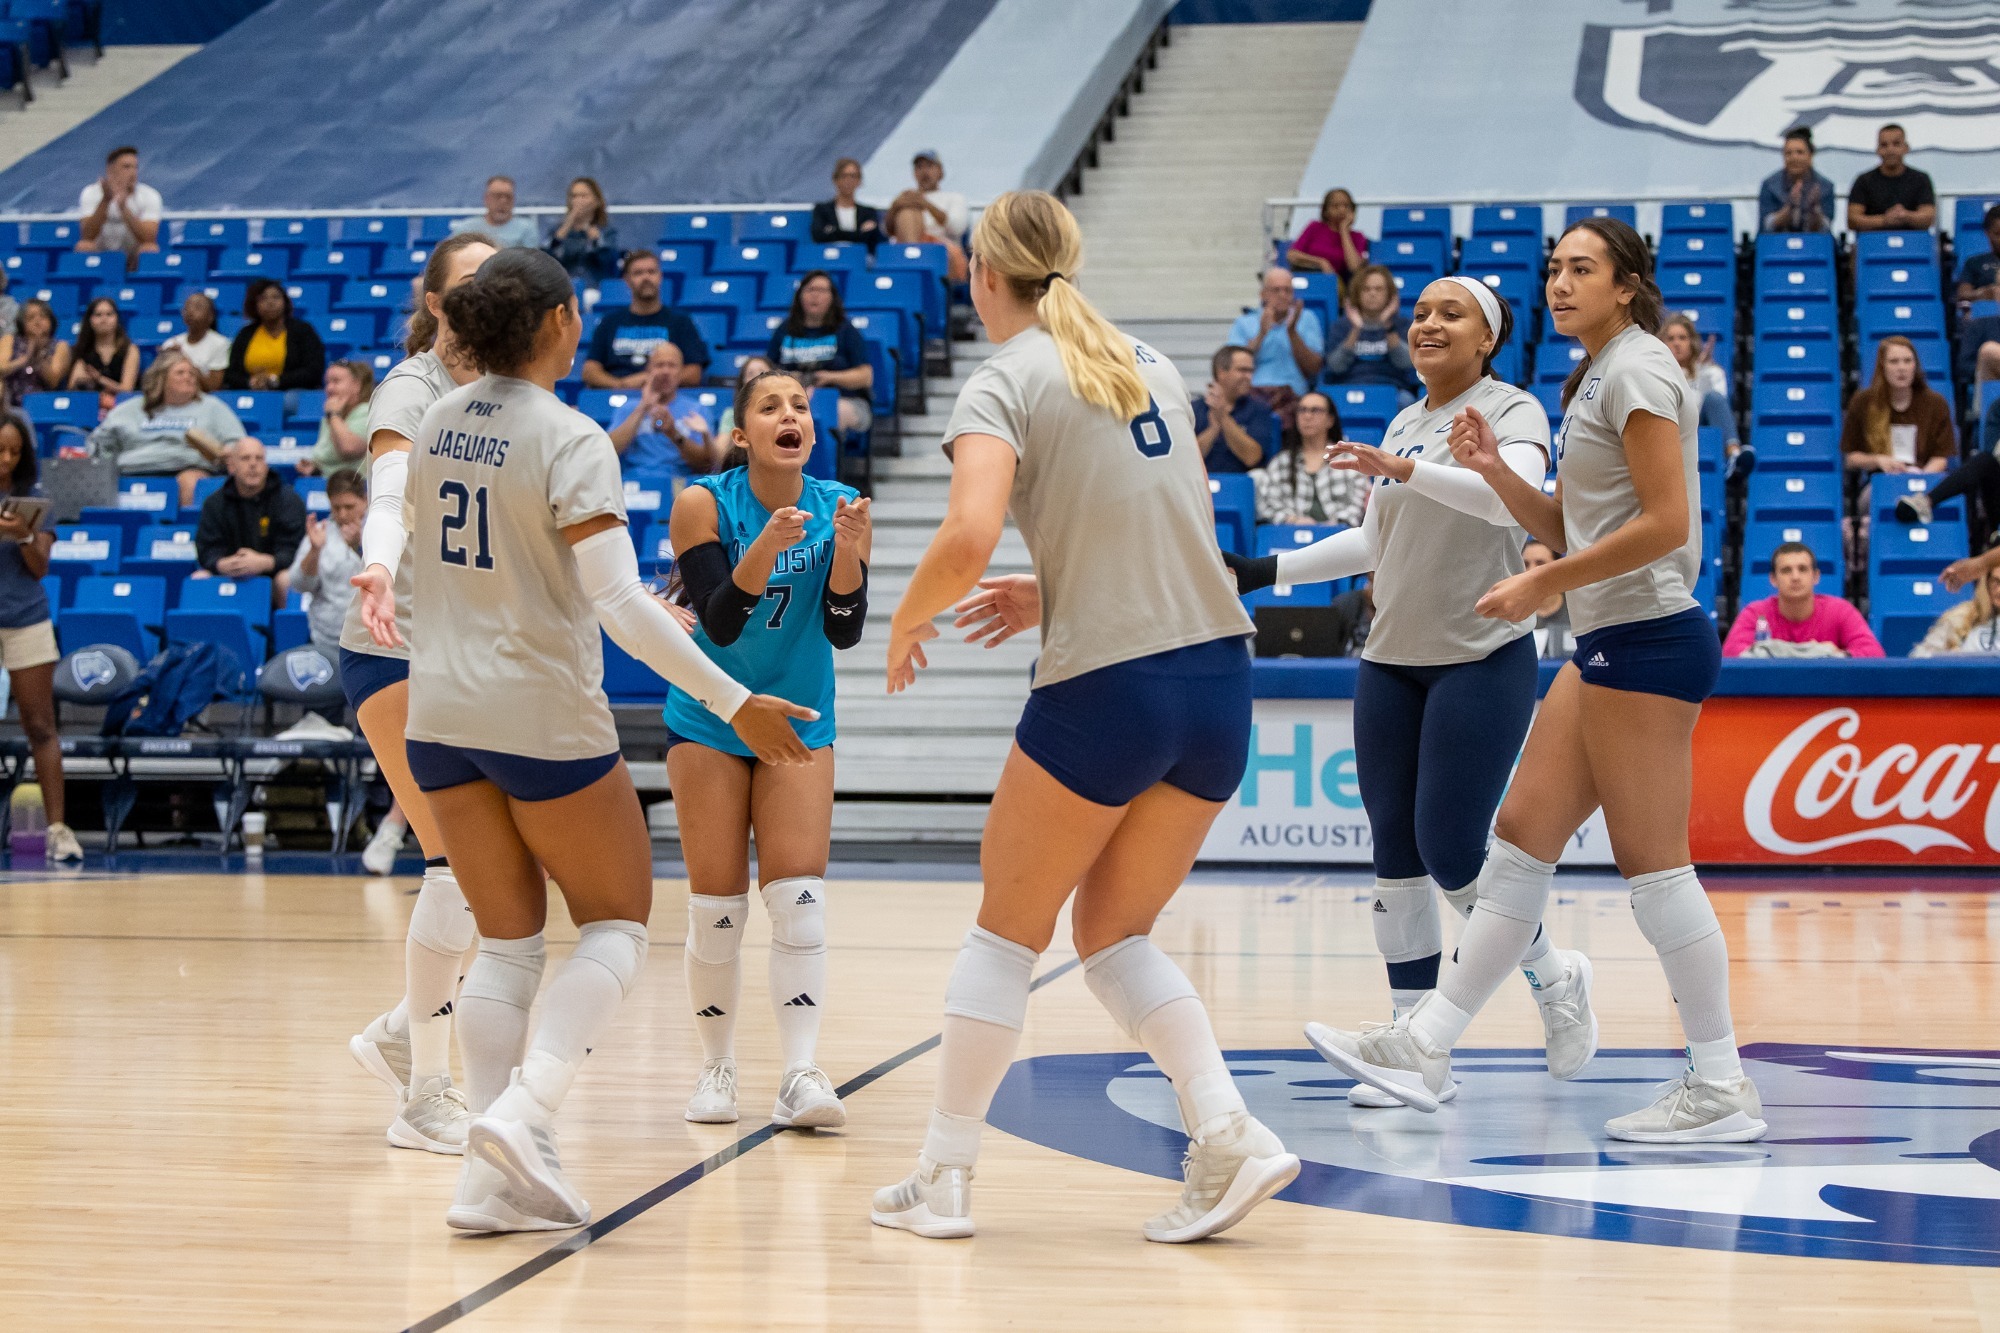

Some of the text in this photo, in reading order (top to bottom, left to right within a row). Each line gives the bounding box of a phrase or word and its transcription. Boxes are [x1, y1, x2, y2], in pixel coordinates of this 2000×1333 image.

[464, 400, 502, 418] PBC
[1128, 391, 1174, 459] 8
[429, 428, 510, 468] JAGUARS
[438, 479, 495, 573] 21
[764, 584, 792, 629] 7
[1743, 706, 2000, 856] Coca
